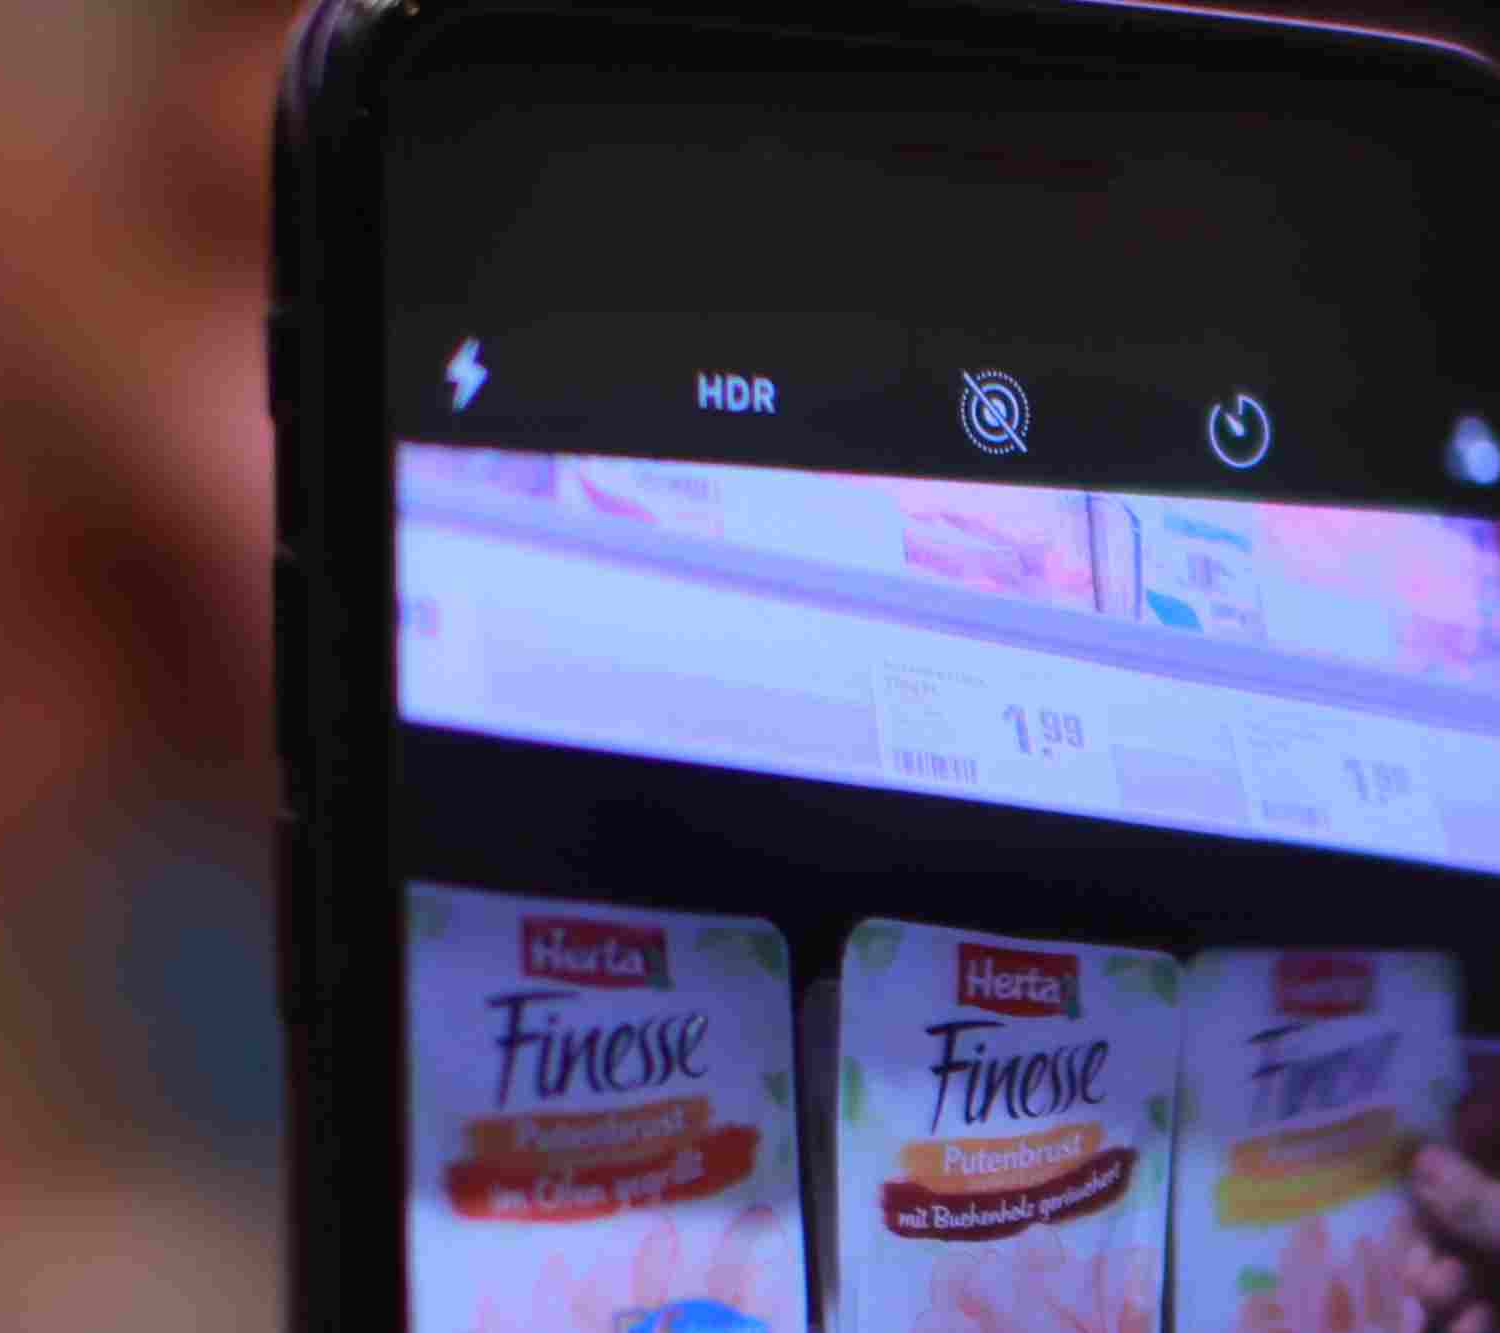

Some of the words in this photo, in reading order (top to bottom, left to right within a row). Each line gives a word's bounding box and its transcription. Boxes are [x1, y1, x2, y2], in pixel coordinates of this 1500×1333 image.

[697, 371, 777, 414] HDR
[965, 957, 1063, 1004] Herta
[484, 990, 710, 1111] Finesse
[924, 1020, 1110, 1134] Finesse
[896, 1205, 928, 1229] mit
